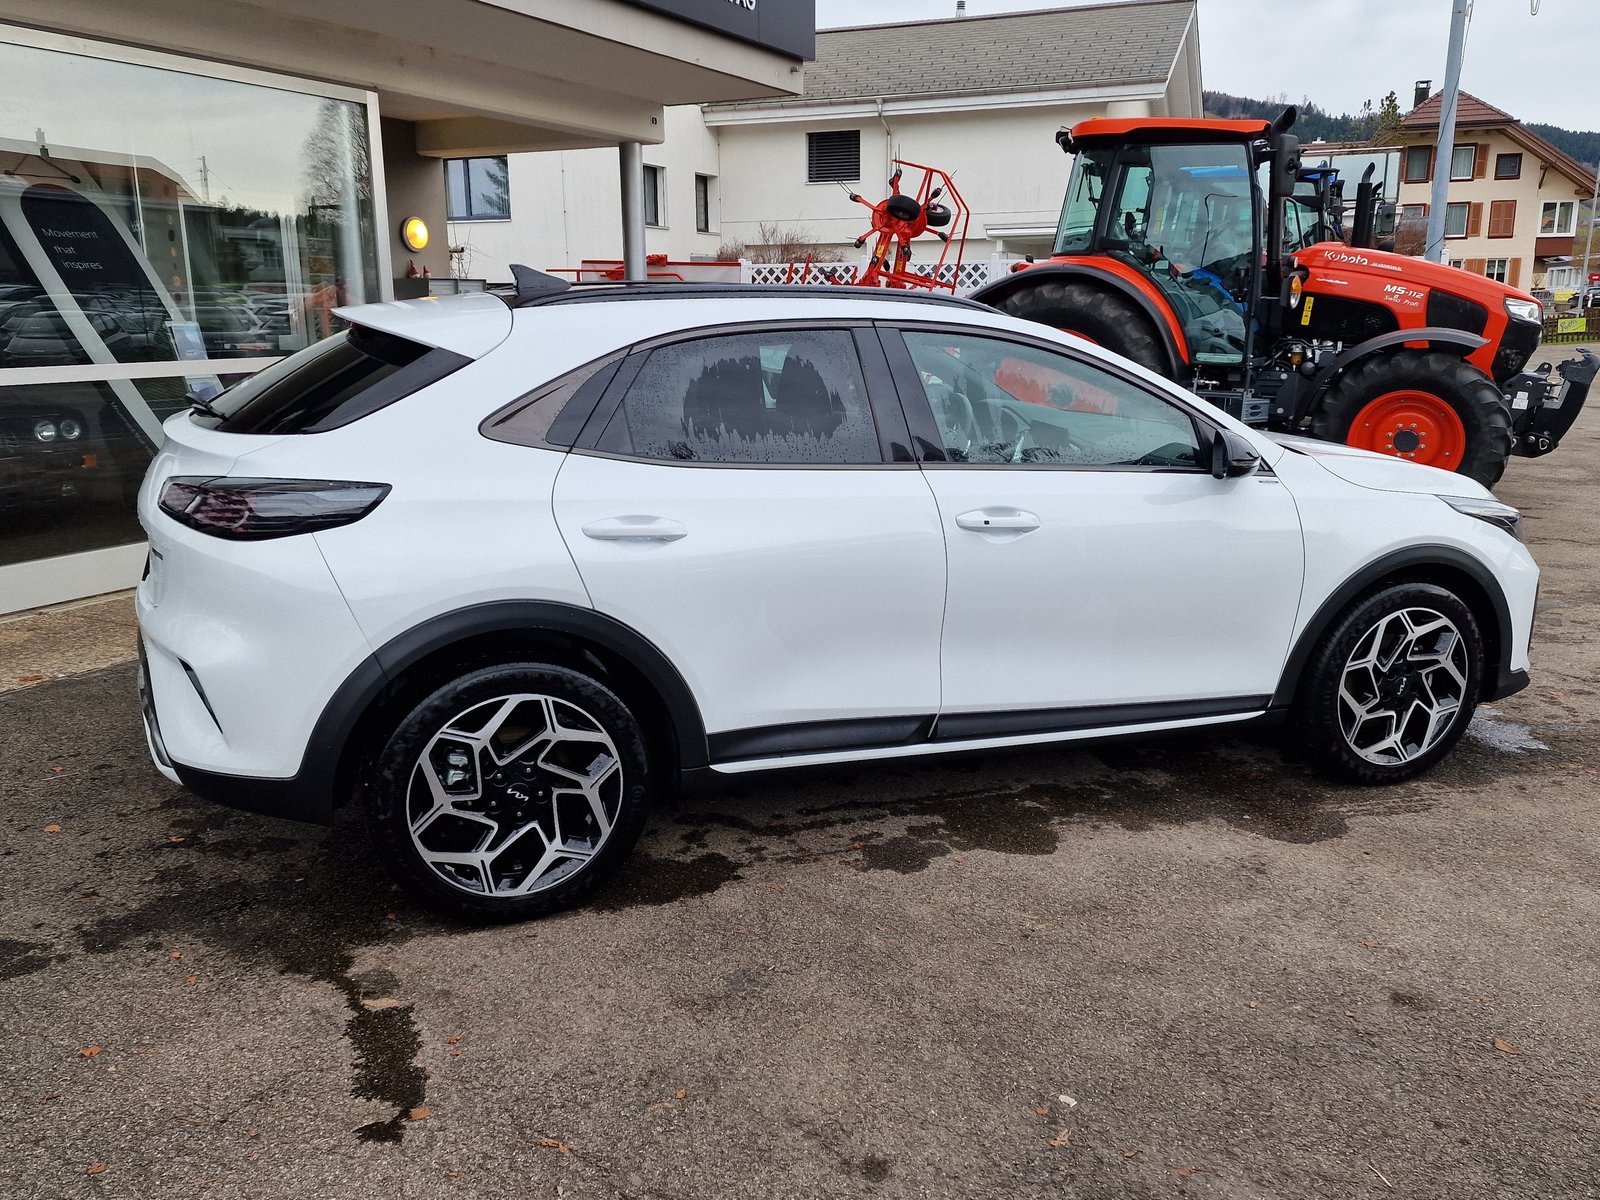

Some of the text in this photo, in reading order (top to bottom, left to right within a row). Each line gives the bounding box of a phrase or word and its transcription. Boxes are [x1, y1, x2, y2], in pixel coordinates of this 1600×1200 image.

[41, 228, 98, 239] Movement
[53, 245, 76, 254] that
[1324, 251, 1368, 265] Kubota
[62, 260, 103, 271] inspires
[1403, 299, 1419, 307] Profi
